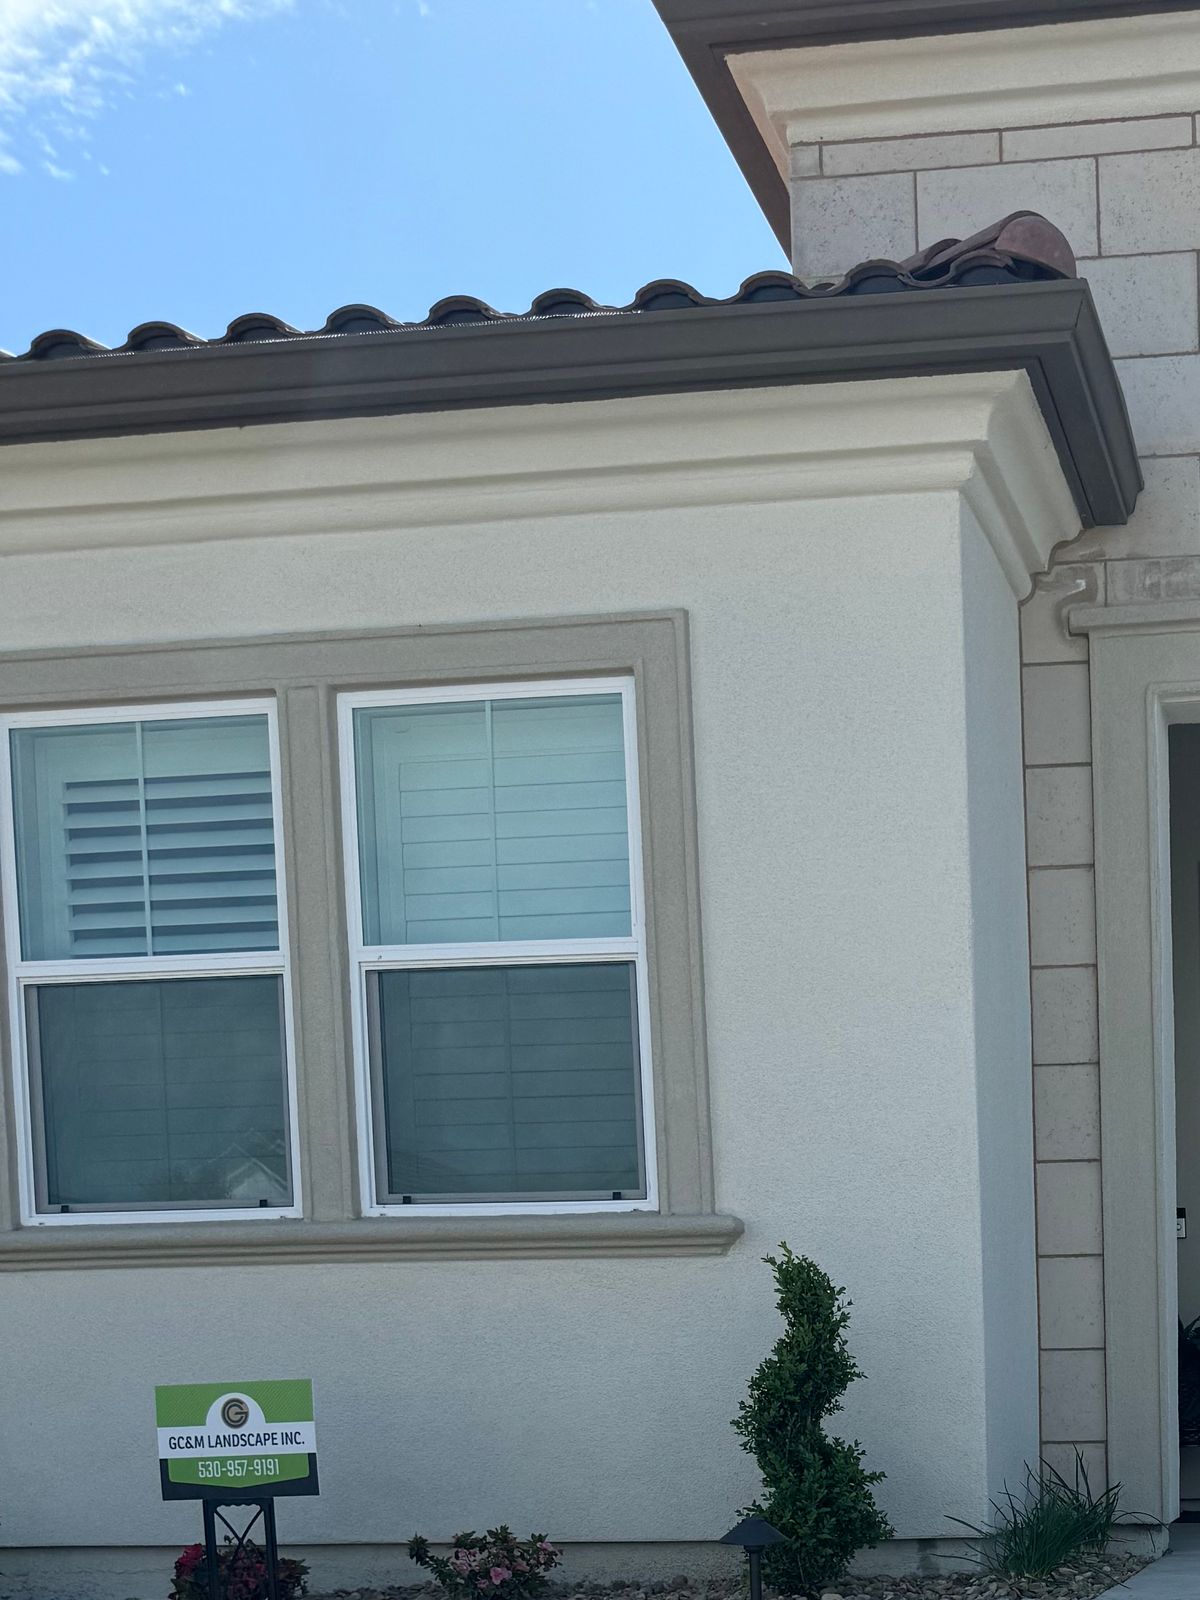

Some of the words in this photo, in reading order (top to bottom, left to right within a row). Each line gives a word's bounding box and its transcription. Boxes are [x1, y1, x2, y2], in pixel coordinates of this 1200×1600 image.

[168, 1435, 205, 1450] GC&M
[208, 1432, 278, 1448] LANDSCAPE
[281, 1431, 305, 1446] INC.
[198, 1458, 280, 1478] 530-957-9191
